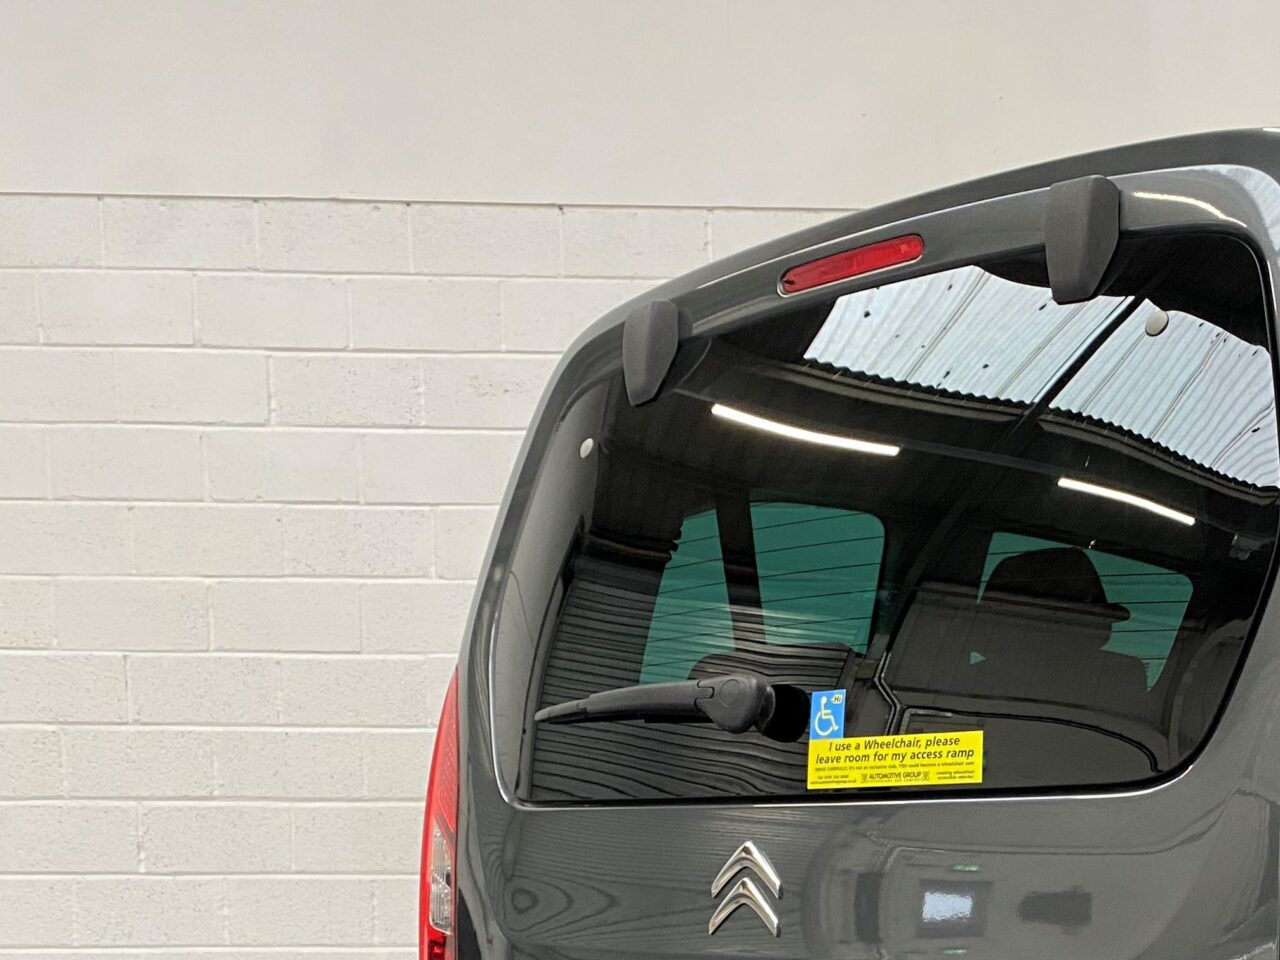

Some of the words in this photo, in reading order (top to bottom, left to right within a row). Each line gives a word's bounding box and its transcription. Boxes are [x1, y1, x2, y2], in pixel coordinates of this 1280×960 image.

[829, 742, 833, 752] I
[835, 743, 851, 751] use
[855, 742, 860, 750] a
[864, 738, 921, 750] Wheelchair,
[924, 736, 960, 749] please
[815, 753, 841, 764] leave
[843, 754, 870, 763] room
[873, 751, 888, 761] for
[891, 752, 907, 763] my
[910, 750, 943, 760] access
[945, 749, 975, 760] ramp
[869, 772, 901, 780] AUTOMOTIVE
